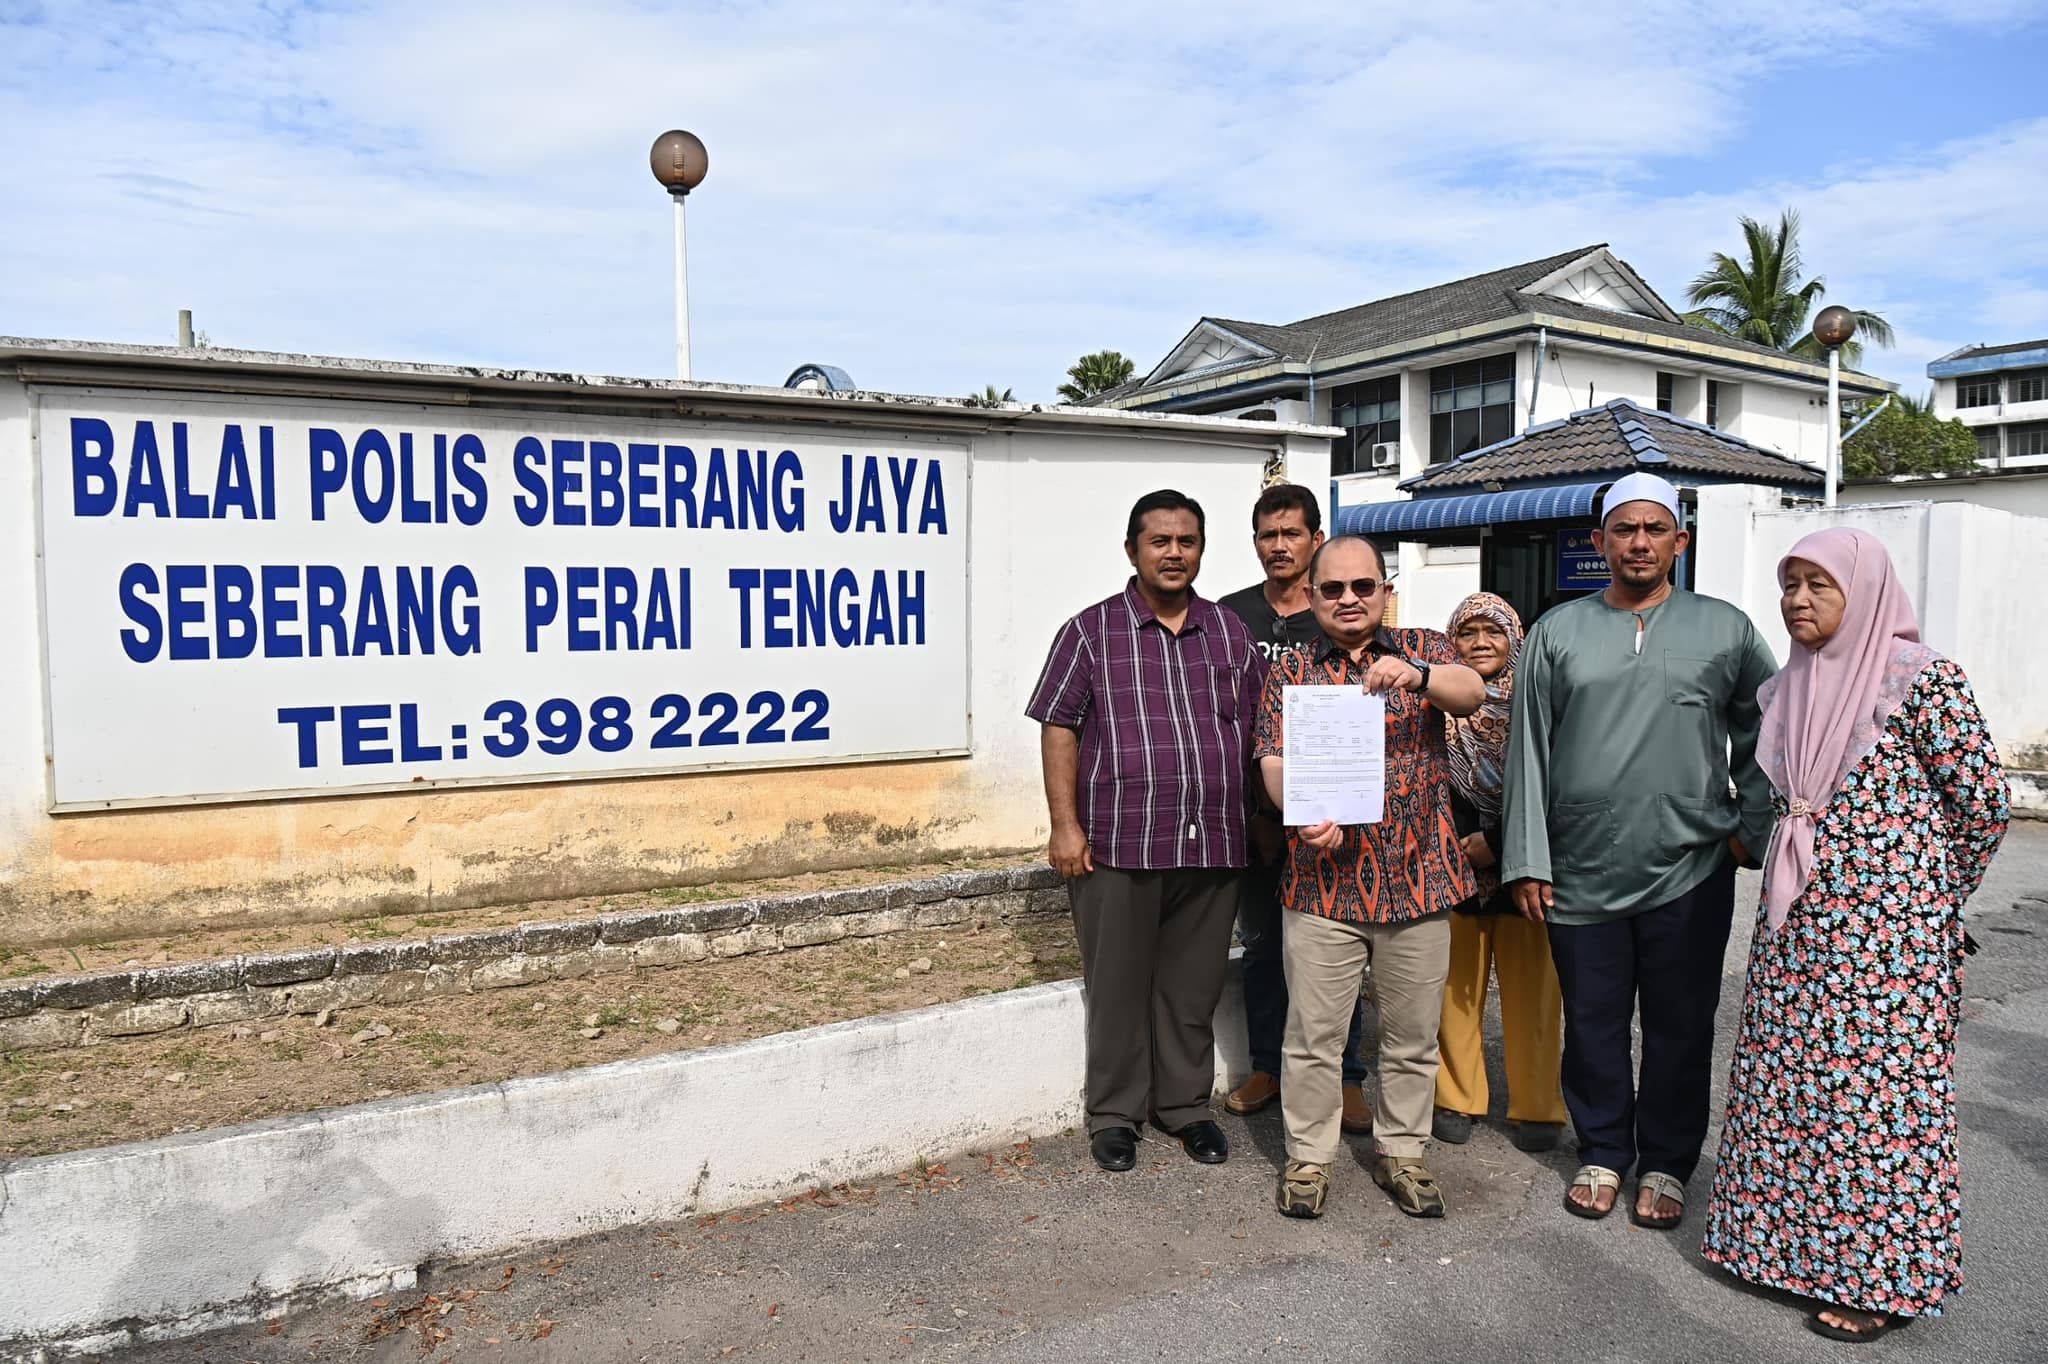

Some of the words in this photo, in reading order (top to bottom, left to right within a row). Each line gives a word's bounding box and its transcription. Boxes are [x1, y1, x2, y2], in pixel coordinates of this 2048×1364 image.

[71, 417, 276, 520] BALAI
[309, 428, 488, 526] POLIS
[513, 436, 805, 533] SEBERANG
[829, 454, 948, 535] JAYA
[119, 563, 481, 664] SEBERANG
[525, 566, 691, 653] PERAI
[729, 568, 925, 649] TENGAH
[483, 696, 633, 758] 398
[650, 689, 830, 749] 2222
